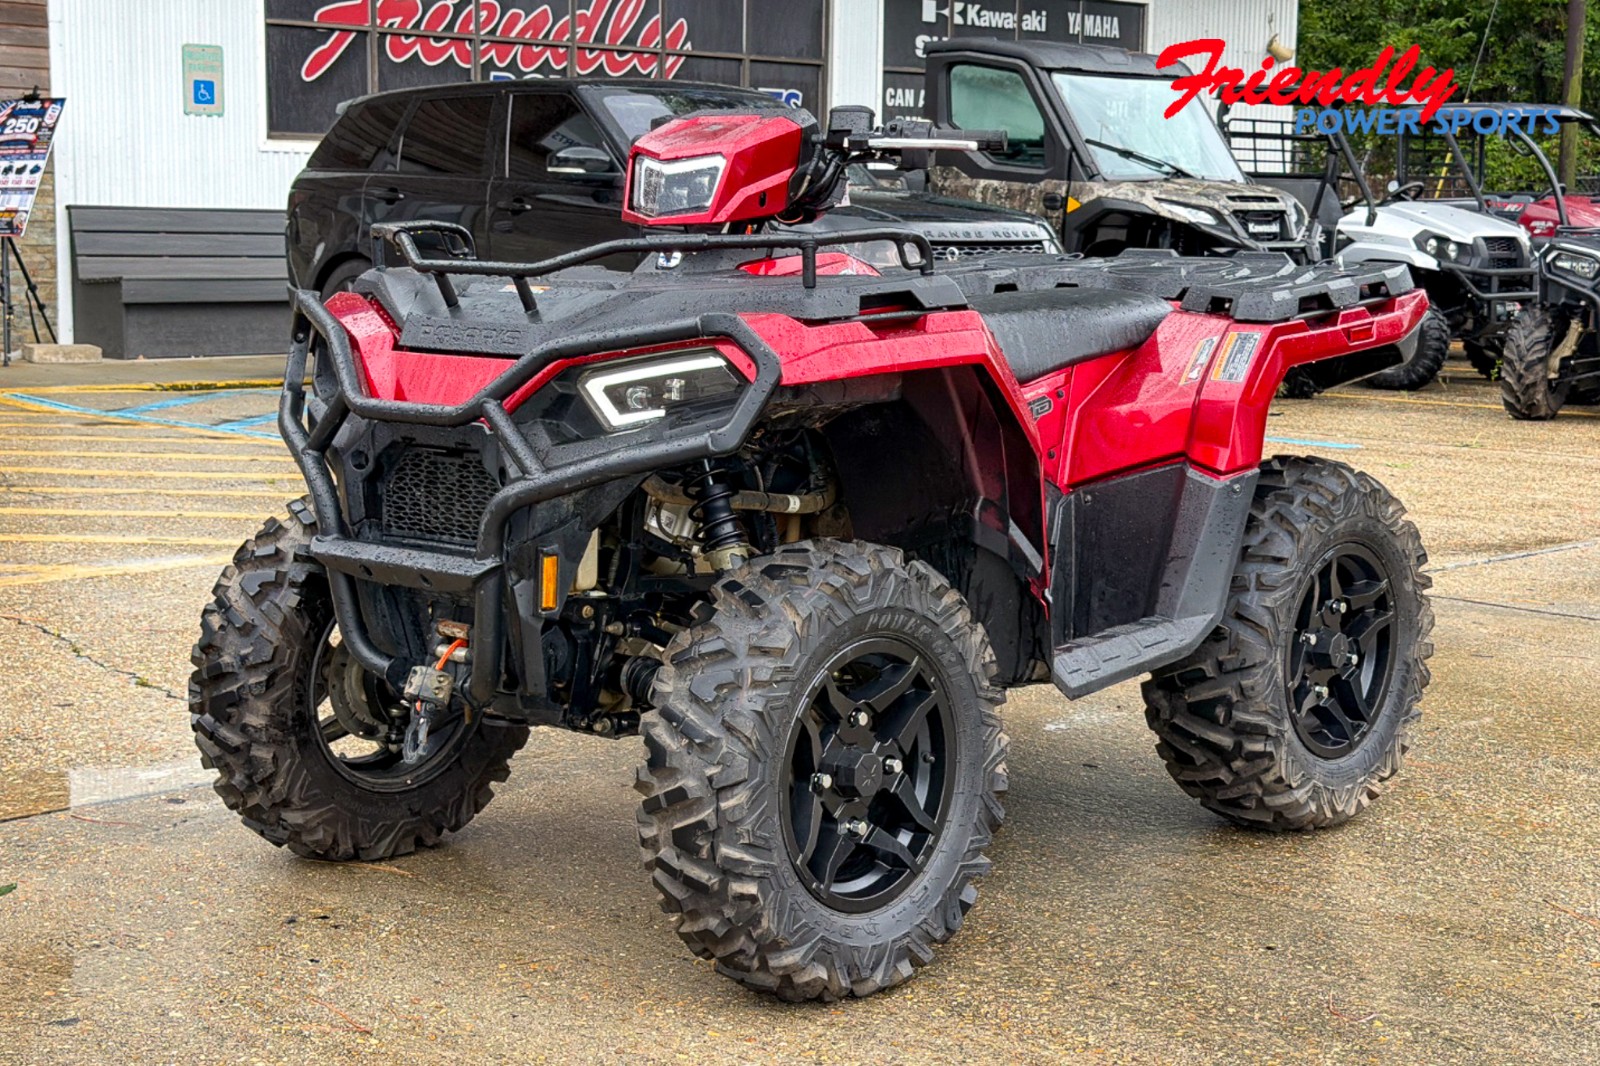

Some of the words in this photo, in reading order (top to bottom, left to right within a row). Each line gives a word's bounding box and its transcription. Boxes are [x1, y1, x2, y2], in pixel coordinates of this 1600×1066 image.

[1067, 11, 1120, 39] YAMAHA
[301, 0, 692, 81] Friendly
[885, 88, 909, 107] CAN
[3, 117, 39, 134] 250
